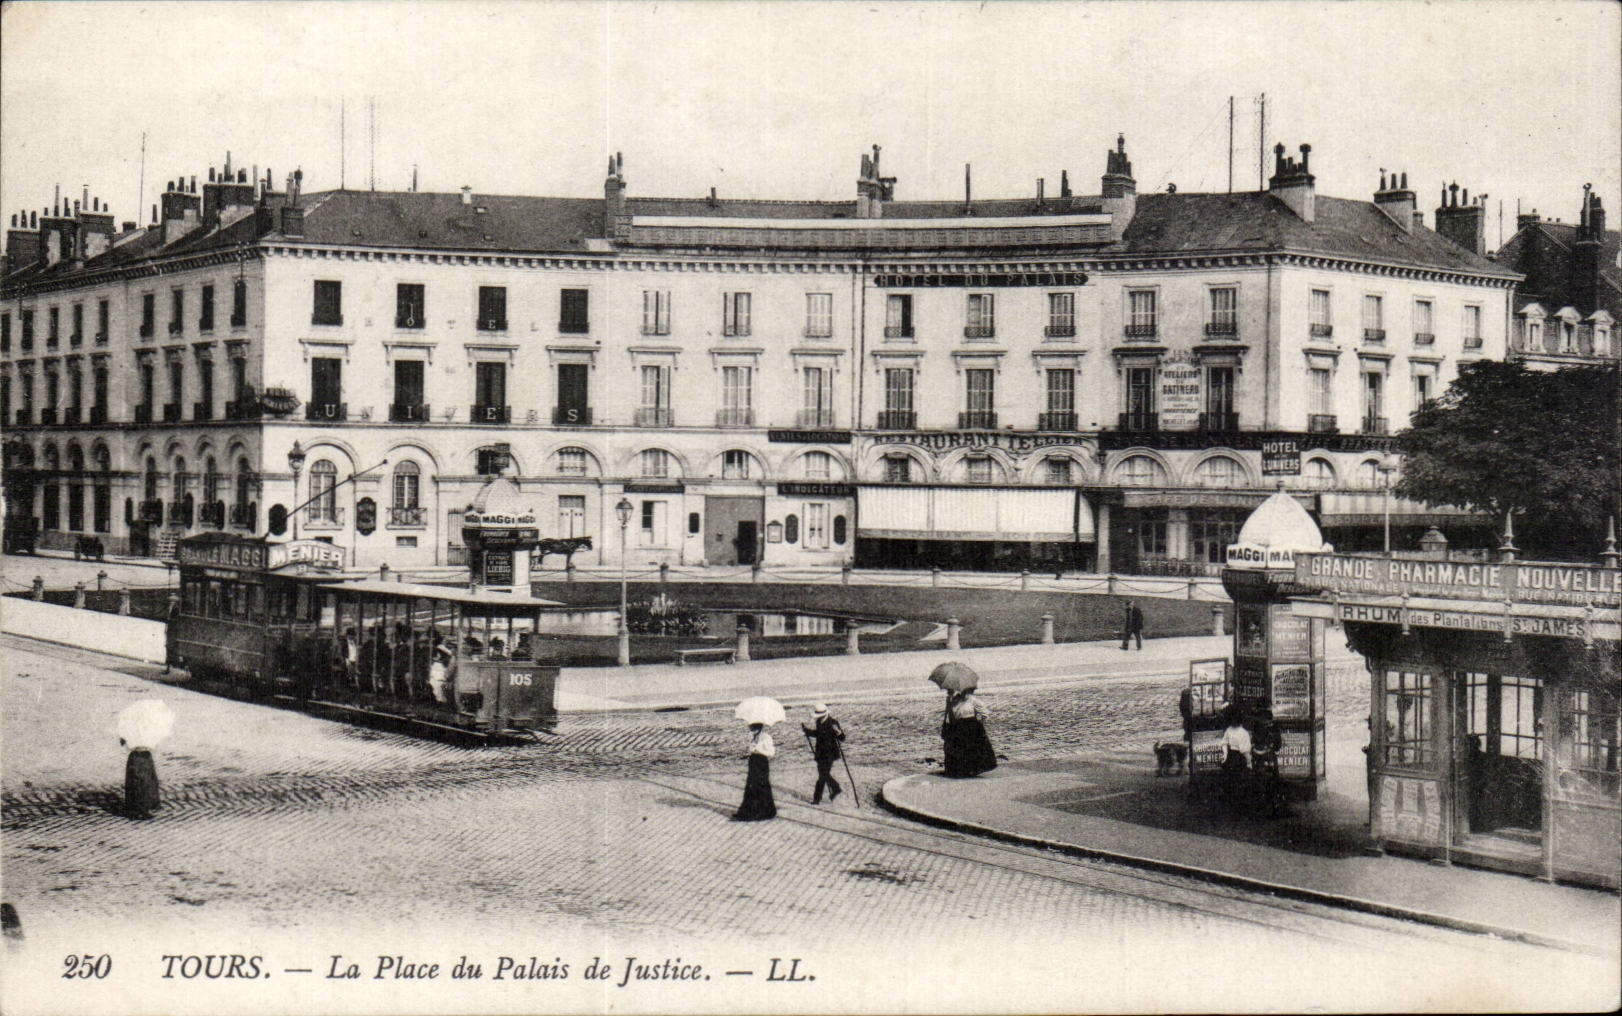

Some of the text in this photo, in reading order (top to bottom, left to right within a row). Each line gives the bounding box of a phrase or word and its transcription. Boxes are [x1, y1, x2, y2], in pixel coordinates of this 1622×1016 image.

[880, 273, 1084, 287] HOTEL DU PALAIS
[874, 433, 999, 449] RESTAURANT
[1263, 442, 1299, 453] HOTEL
[482, 514, 515, 524] MAGGI
[269, 544, 344, 567] MENIER
[1229, 548, 1265, 562] MAGGI
[1270, 551, 1296, 562] MA
[1311, 556, 1375, 580] GRANDE
[1388, 561, 1500, 588] PHARMACIE
[1515, 567, 1621, 593] NOUVELLE
[1343, 606, 1400, 626] RHUM
[1410, 612, 1428, 625] des
[1433, 612, 1504, 632] Plantations
[1531, 620, 1585, 637] JAMES
[1275, 632, 1307, 641] MENIER
[509, 673, 533, 686] 105
[1277, 757, 1308, 766] MENIER
